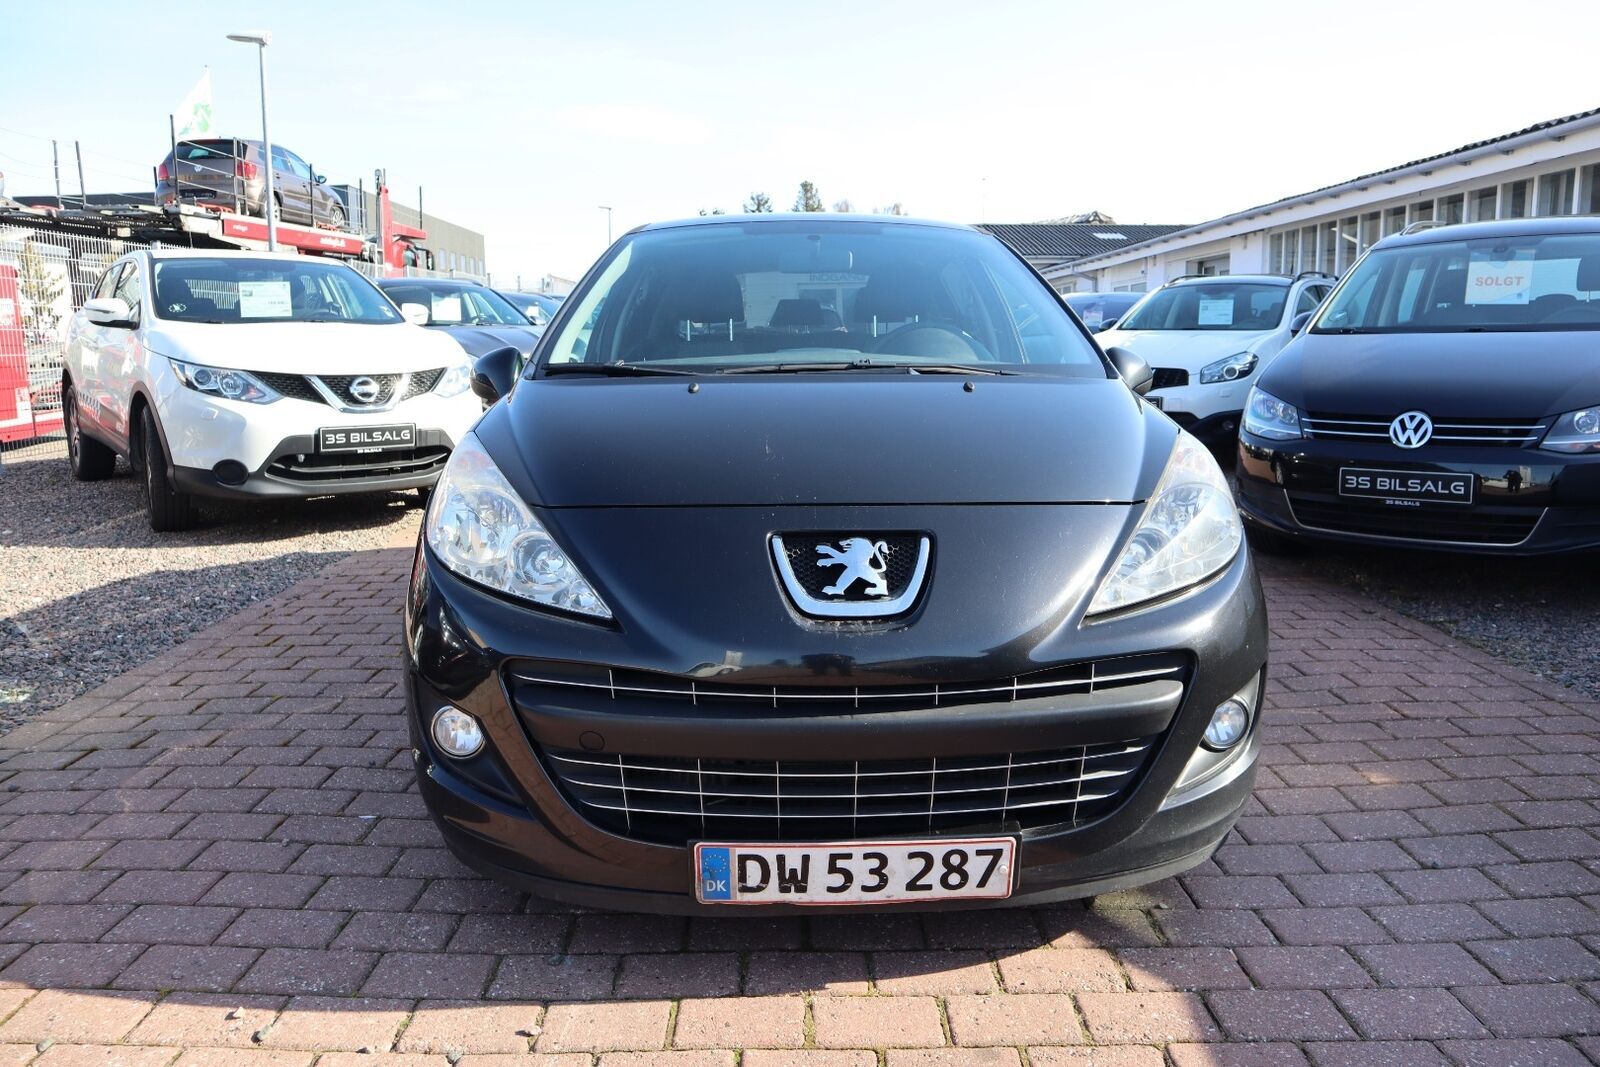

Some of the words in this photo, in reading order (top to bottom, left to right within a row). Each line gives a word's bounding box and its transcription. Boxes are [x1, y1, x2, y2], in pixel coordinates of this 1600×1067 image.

[1475, 276, 1524, 287] SOLGT
[325, 433, 346, 445] 3S
[350, 430, 411, 443] BILSALG
[1345, 475, 1371, 489] 3S
[1376, 477, 1465, 495] BILSALG
[737, 853, 811, 894] DW
[826, 851, 889, 894] 53
[905, 848, 1004, 892] 287
[706, 879, 726, 893] DK
